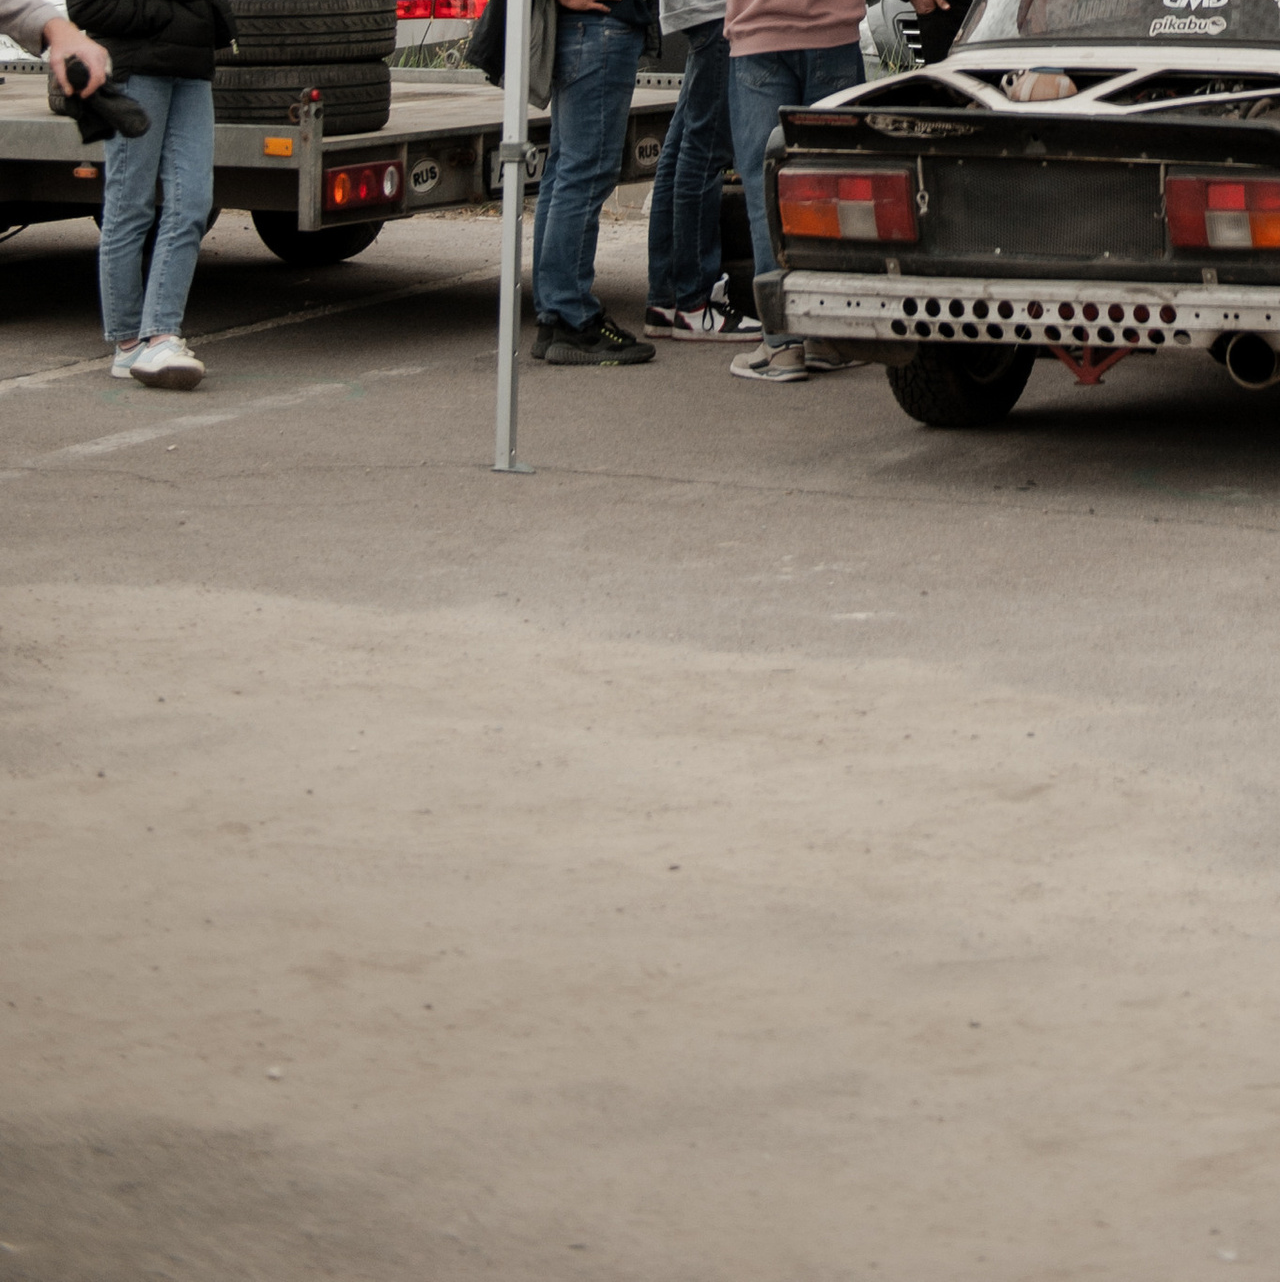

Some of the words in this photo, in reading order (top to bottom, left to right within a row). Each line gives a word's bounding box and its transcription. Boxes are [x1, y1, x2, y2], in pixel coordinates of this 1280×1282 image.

[1151, 16, 1208, 35] pikabu
[638, 145, 660, 160] RUS
[412, 166, 438, 187] RUS
